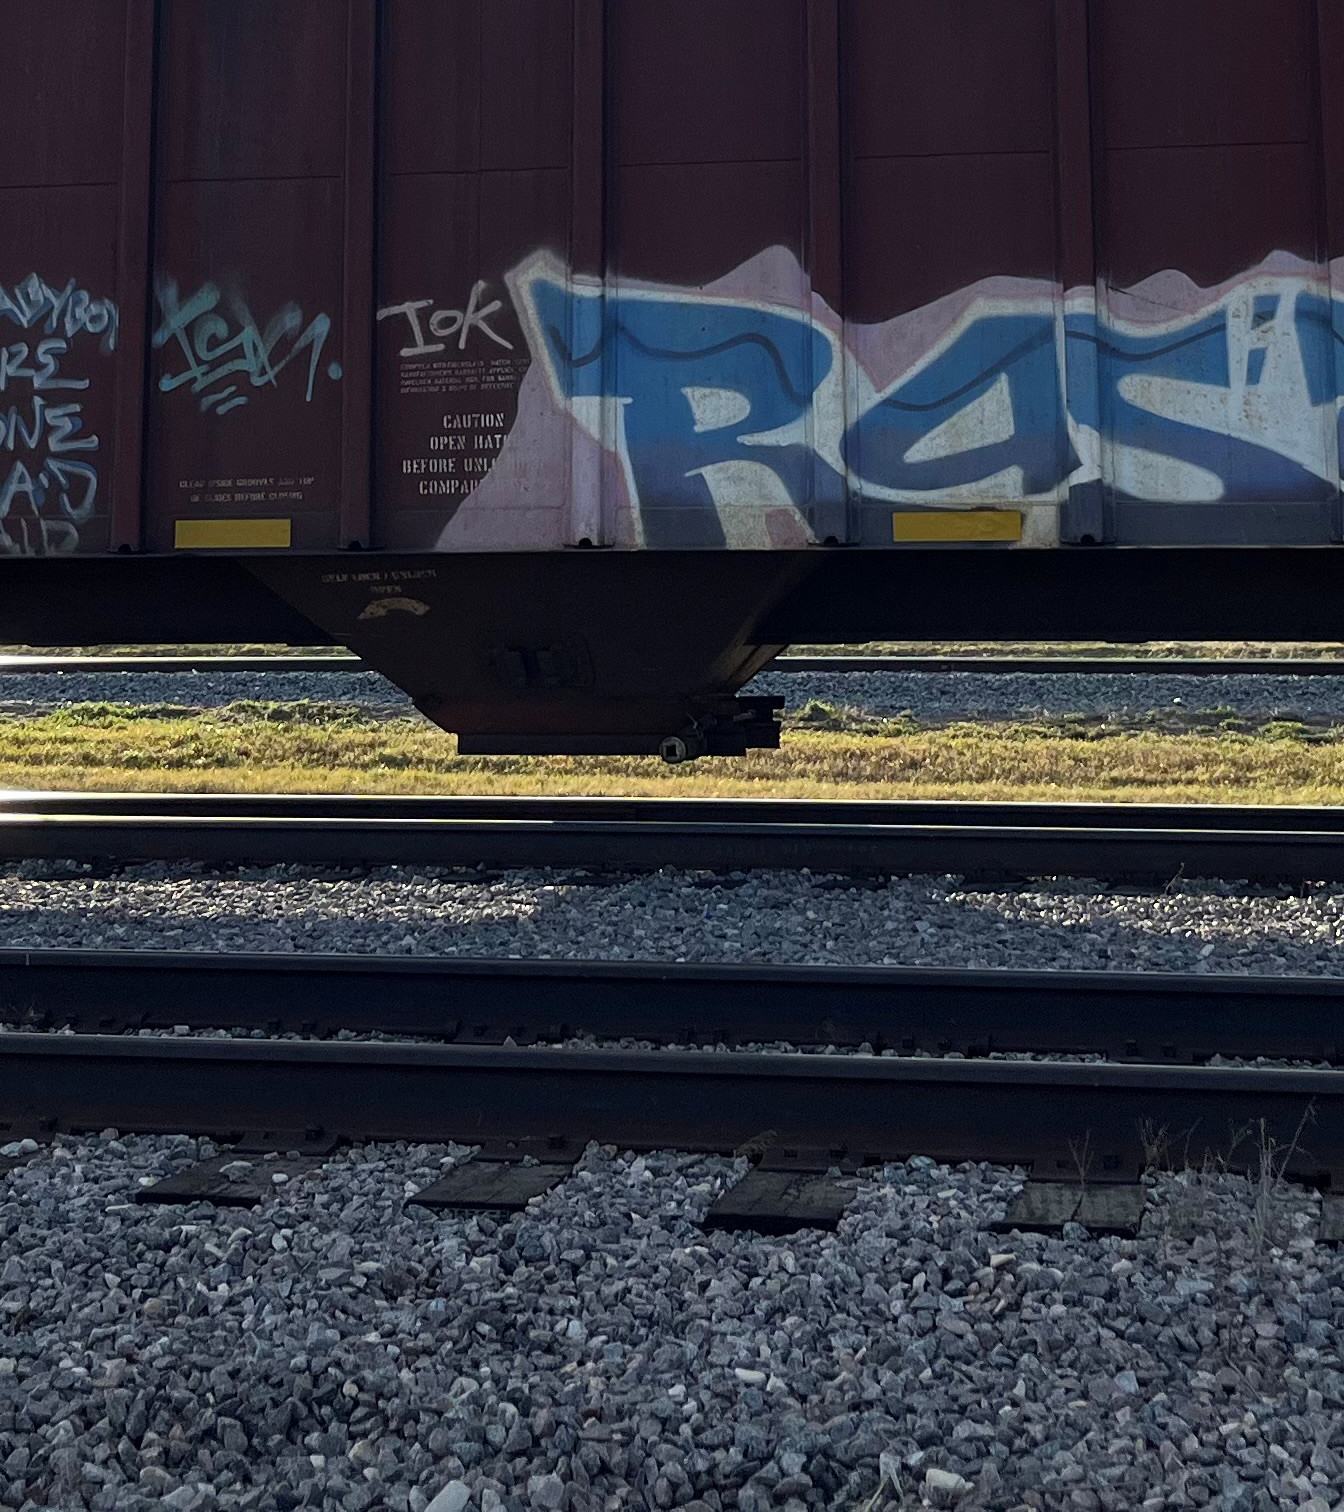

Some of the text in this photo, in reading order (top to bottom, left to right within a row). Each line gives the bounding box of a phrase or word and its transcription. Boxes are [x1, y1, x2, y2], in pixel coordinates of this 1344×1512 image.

[443, 412, 505, 429] CAUTION
[429, 435, 467, 451] OPEN
[401, 457, 457, 474] BEFORE
